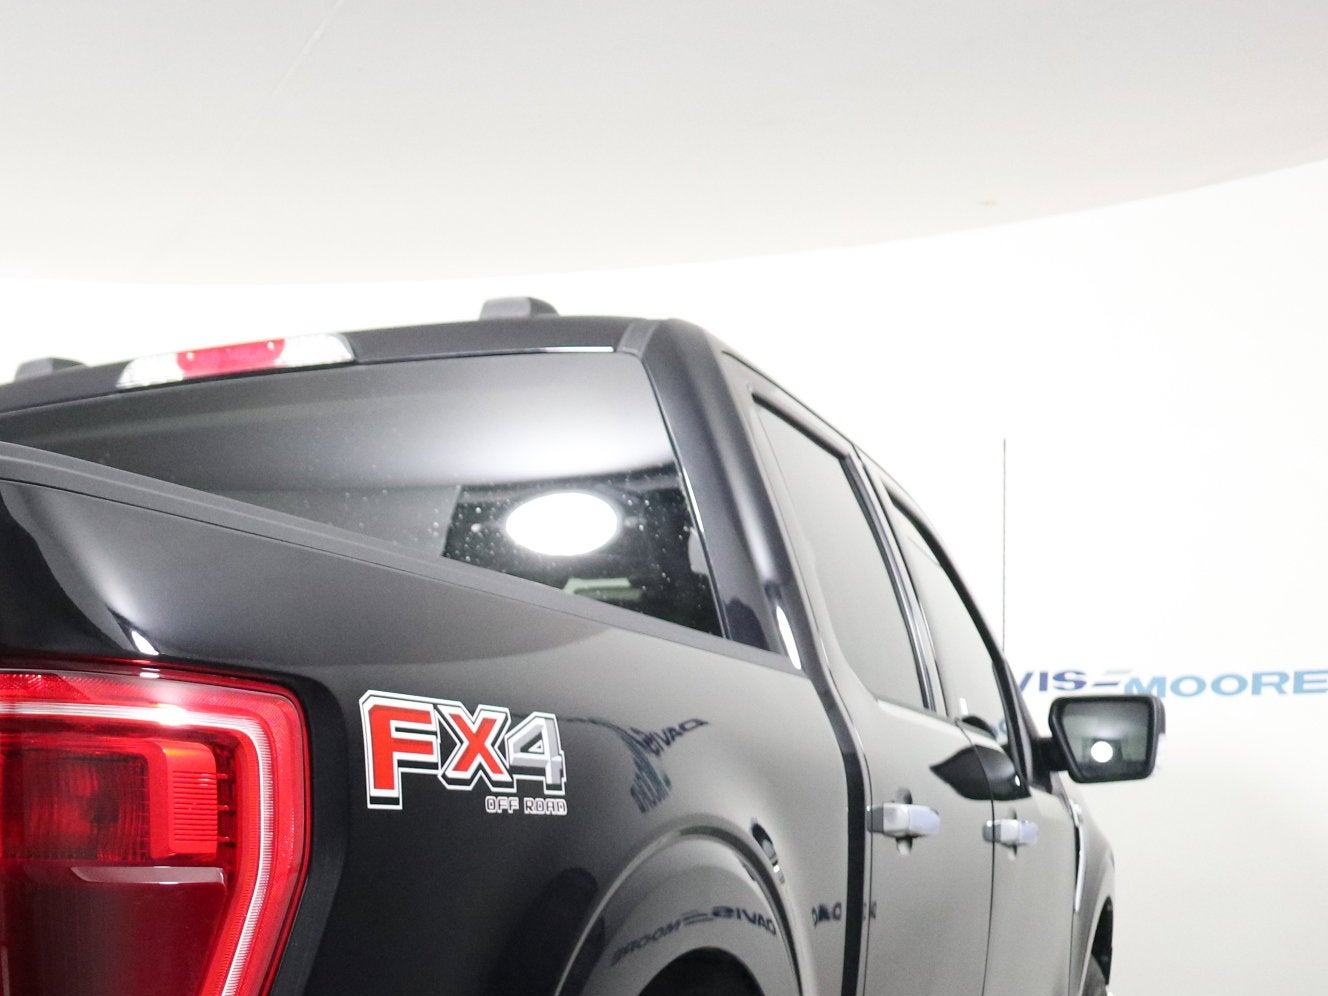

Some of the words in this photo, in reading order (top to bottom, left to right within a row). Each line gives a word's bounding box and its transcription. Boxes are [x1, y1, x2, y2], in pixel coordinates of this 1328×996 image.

[359, 690, 567, 809] FX4
[485, 796, 520, 813] OFF
[524, 797, 568, 815] ROAD
